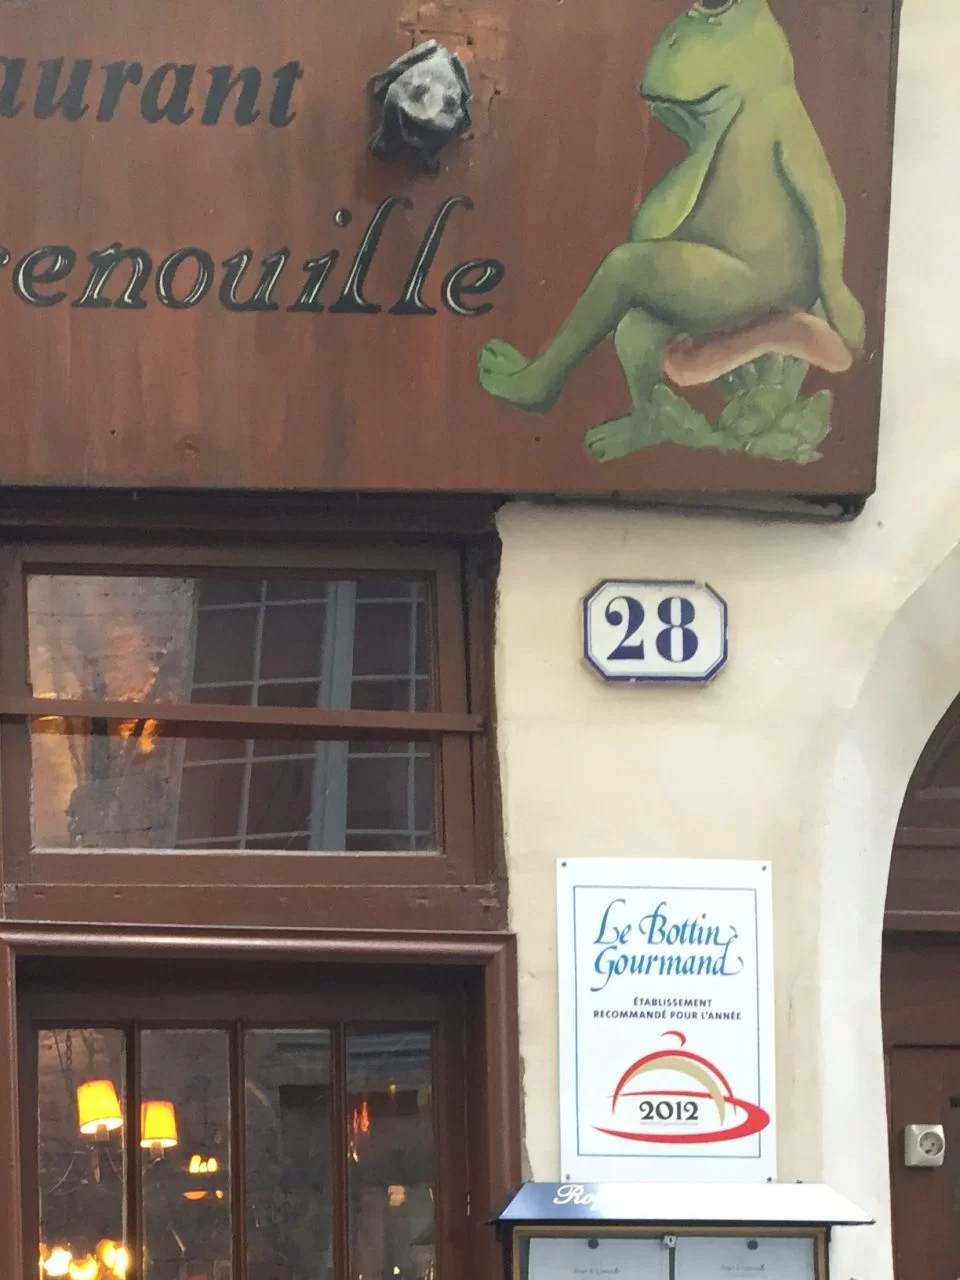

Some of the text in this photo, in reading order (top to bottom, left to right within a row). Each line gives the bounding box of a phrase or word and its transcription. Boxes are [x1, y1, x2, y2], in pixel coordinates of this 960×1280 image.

[605, 596, 698, 662] 28
[593, 898, 738, 946] Le Bottin
[590, 938, 744, 992] Gourmand
[593, 1009, 742, 1021] RECOMMANDÉ POUR L'ANNÉE
[633, 996, 712, 1008] ÉTABLISSEMENT
[639, 1100, 699, 1121] 2012
